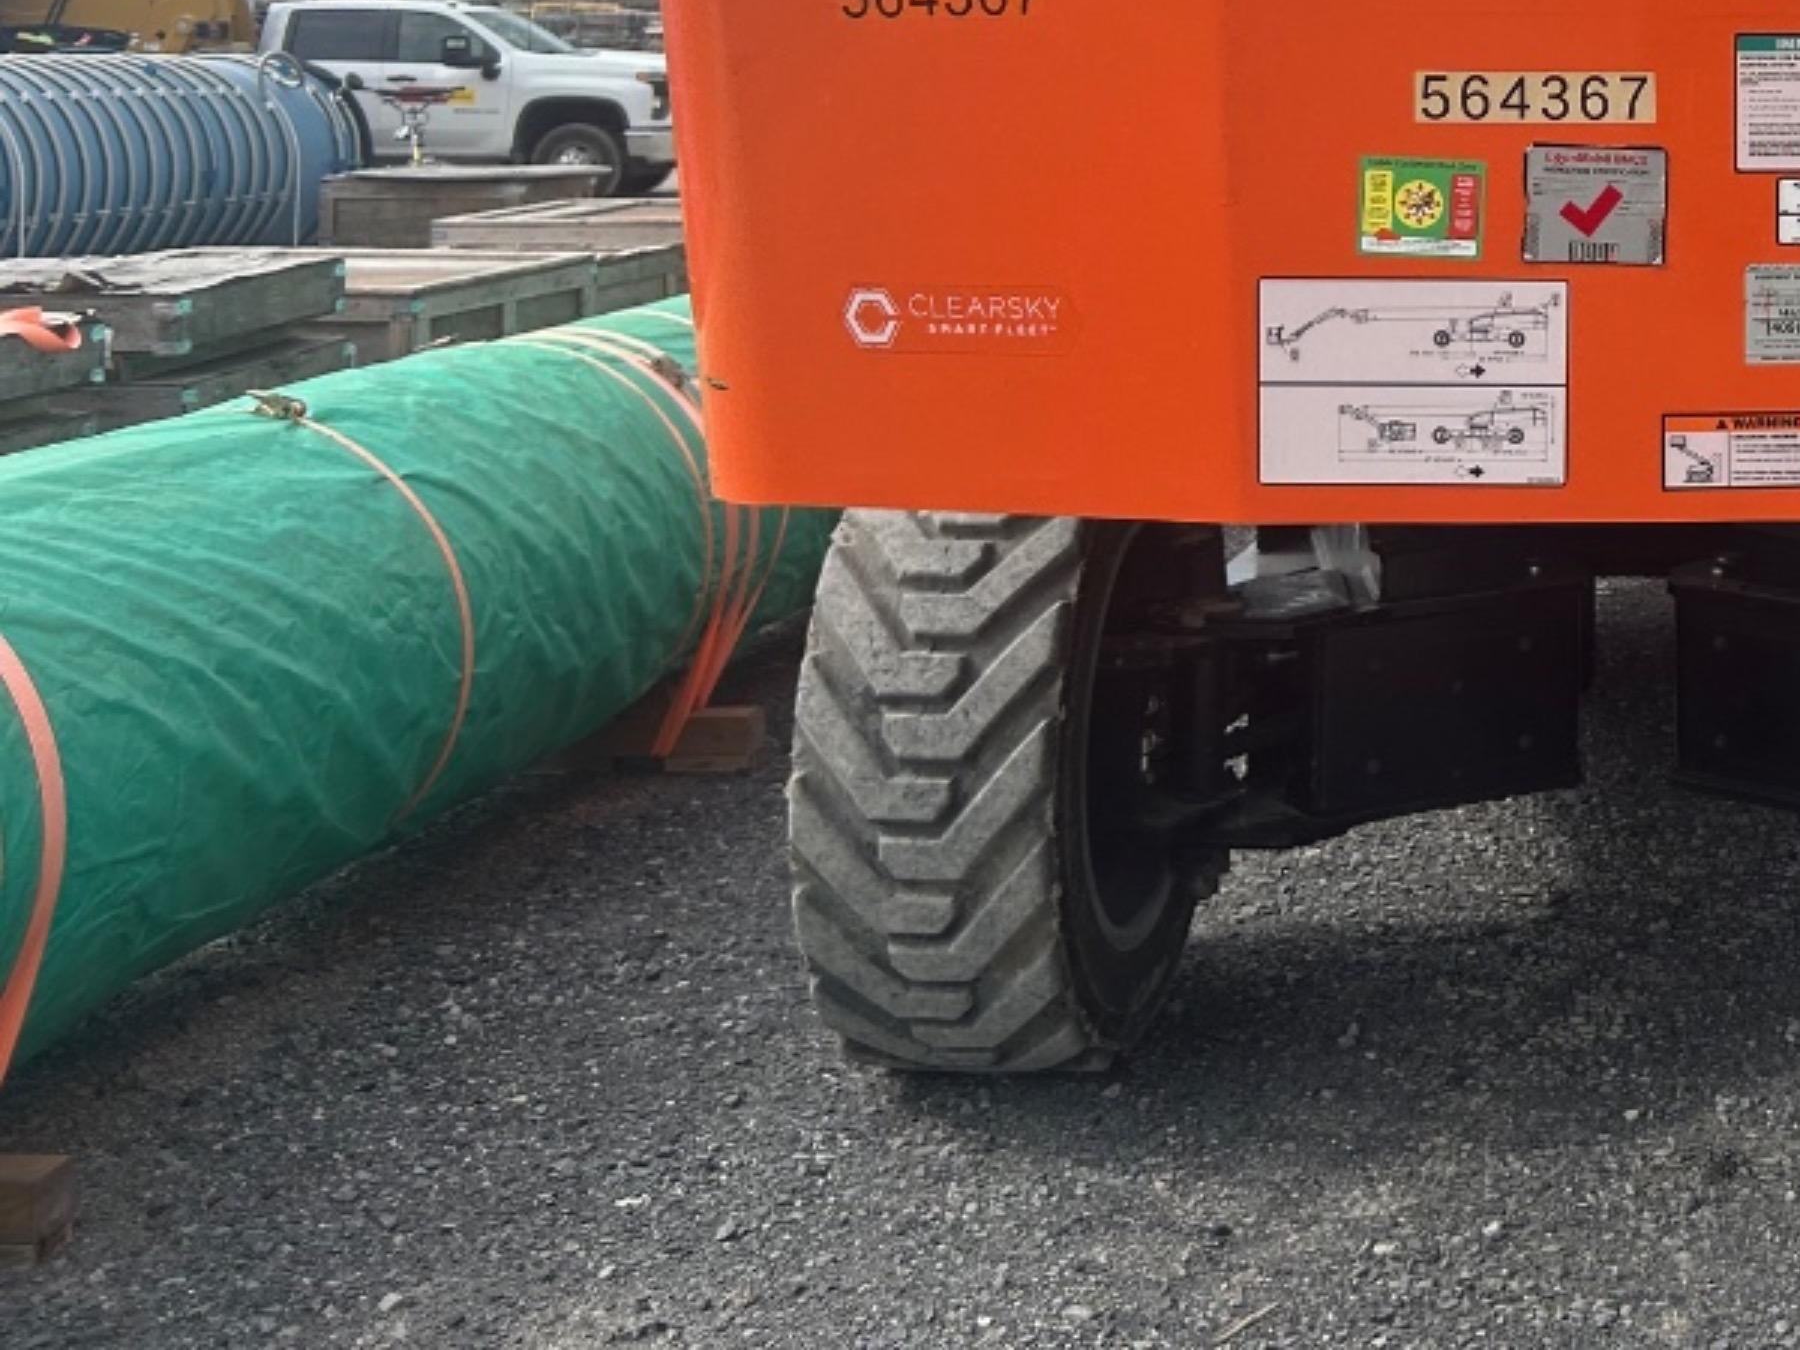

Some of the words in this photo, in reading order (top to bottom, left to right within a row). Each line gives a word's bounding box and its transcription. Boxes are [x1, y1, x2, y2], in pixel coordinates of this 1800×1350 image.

[1420, 74, 1649, 121] 564367
[907, 293, 1061, 320] CLEARSKY
[928, 323, 987, 335] SMART
